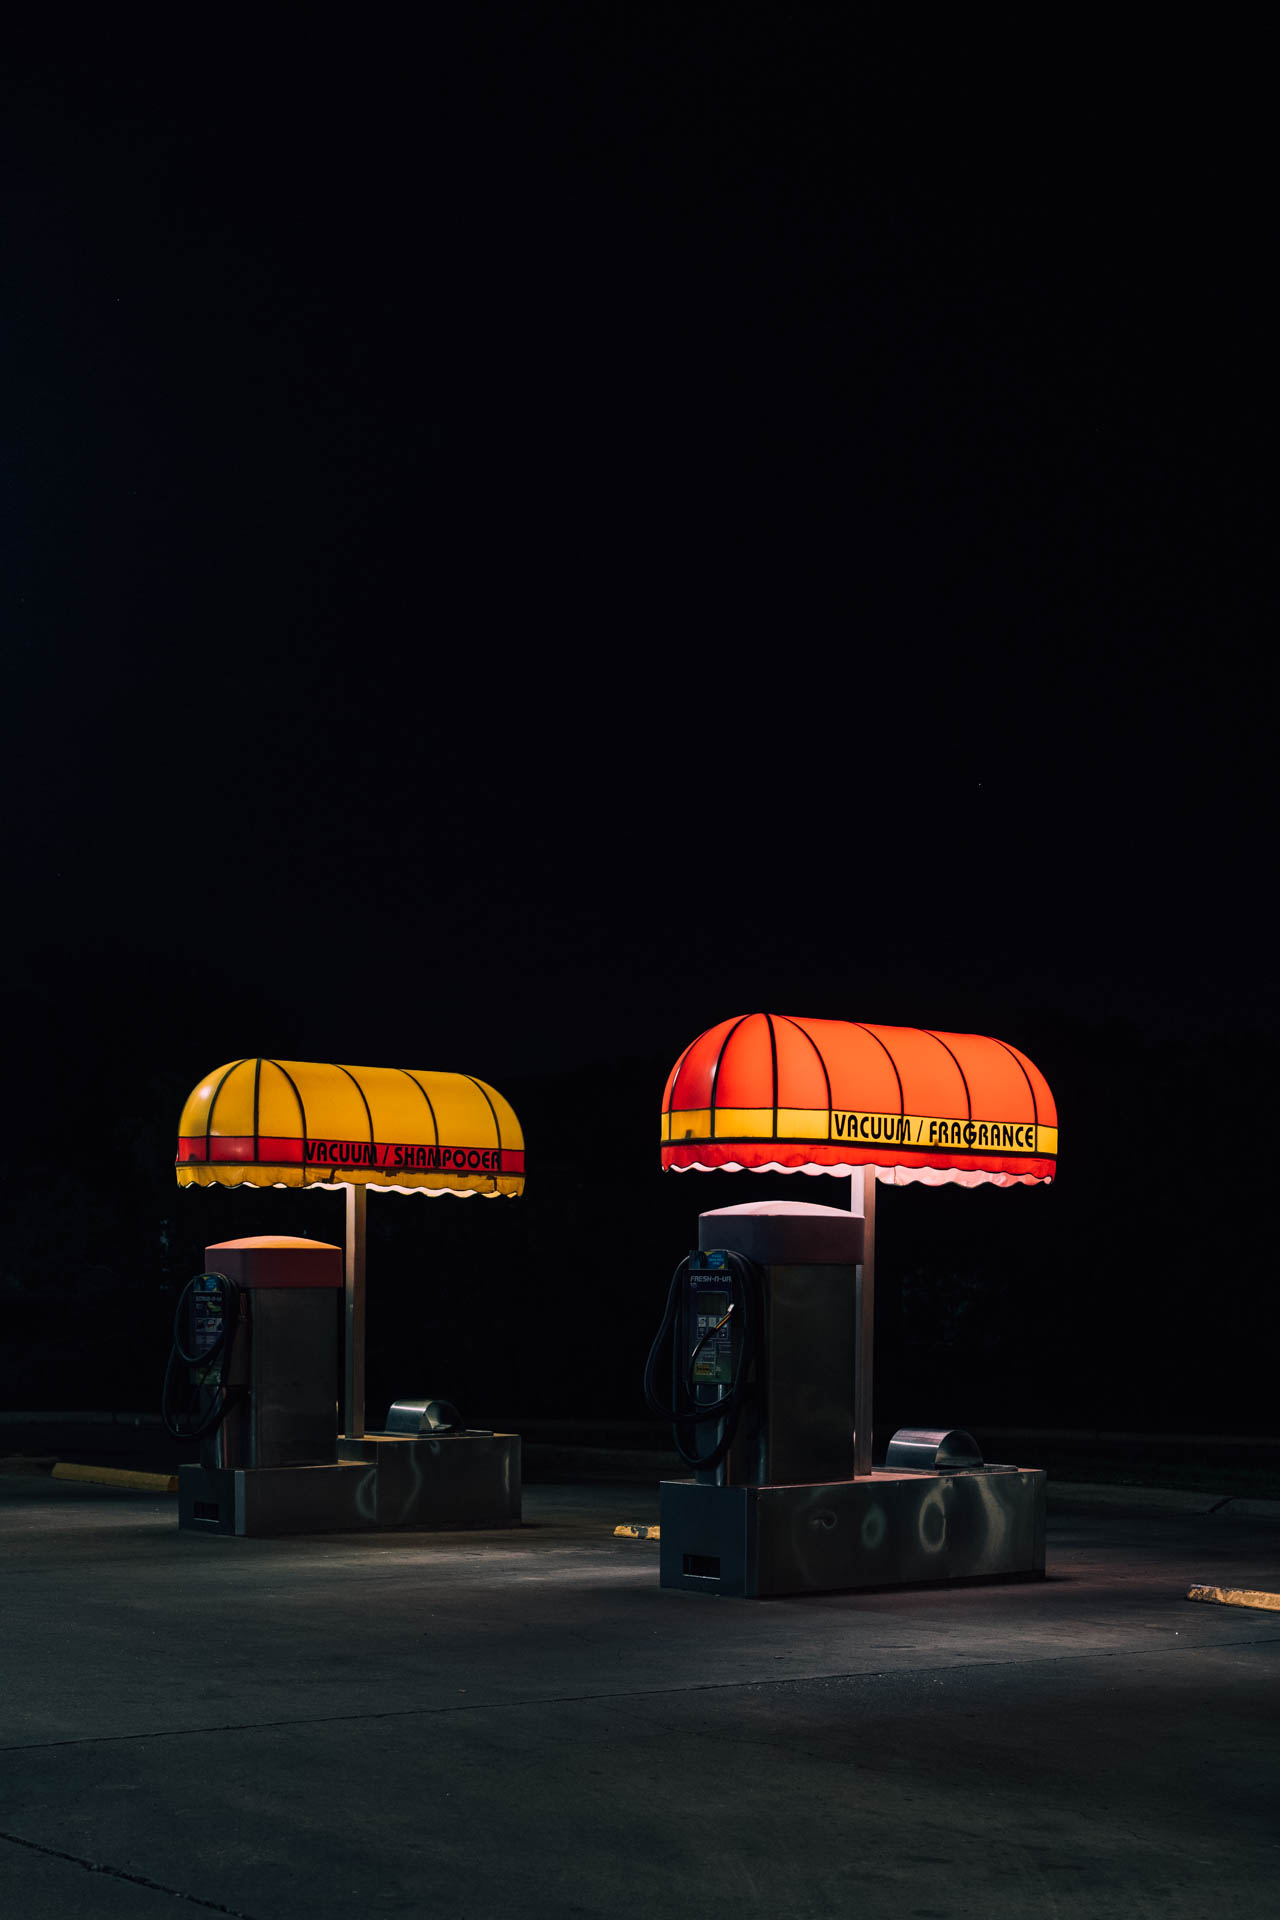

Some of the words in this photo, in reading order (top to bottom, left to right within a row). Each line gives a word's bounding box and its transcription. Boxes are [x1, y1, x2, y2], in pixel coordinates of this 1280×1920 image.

[834, 1113, 911, 1141] VACUUM
[917, 1120, 924, 1142] /
[929, 1121, 1034, 1148] FRAGRANCE
[305, 1142, 377, 1164] VACUUM
[383, 1146, 390, 1165] /
[394, 1146, 502, 1169] SHAMPOOER
